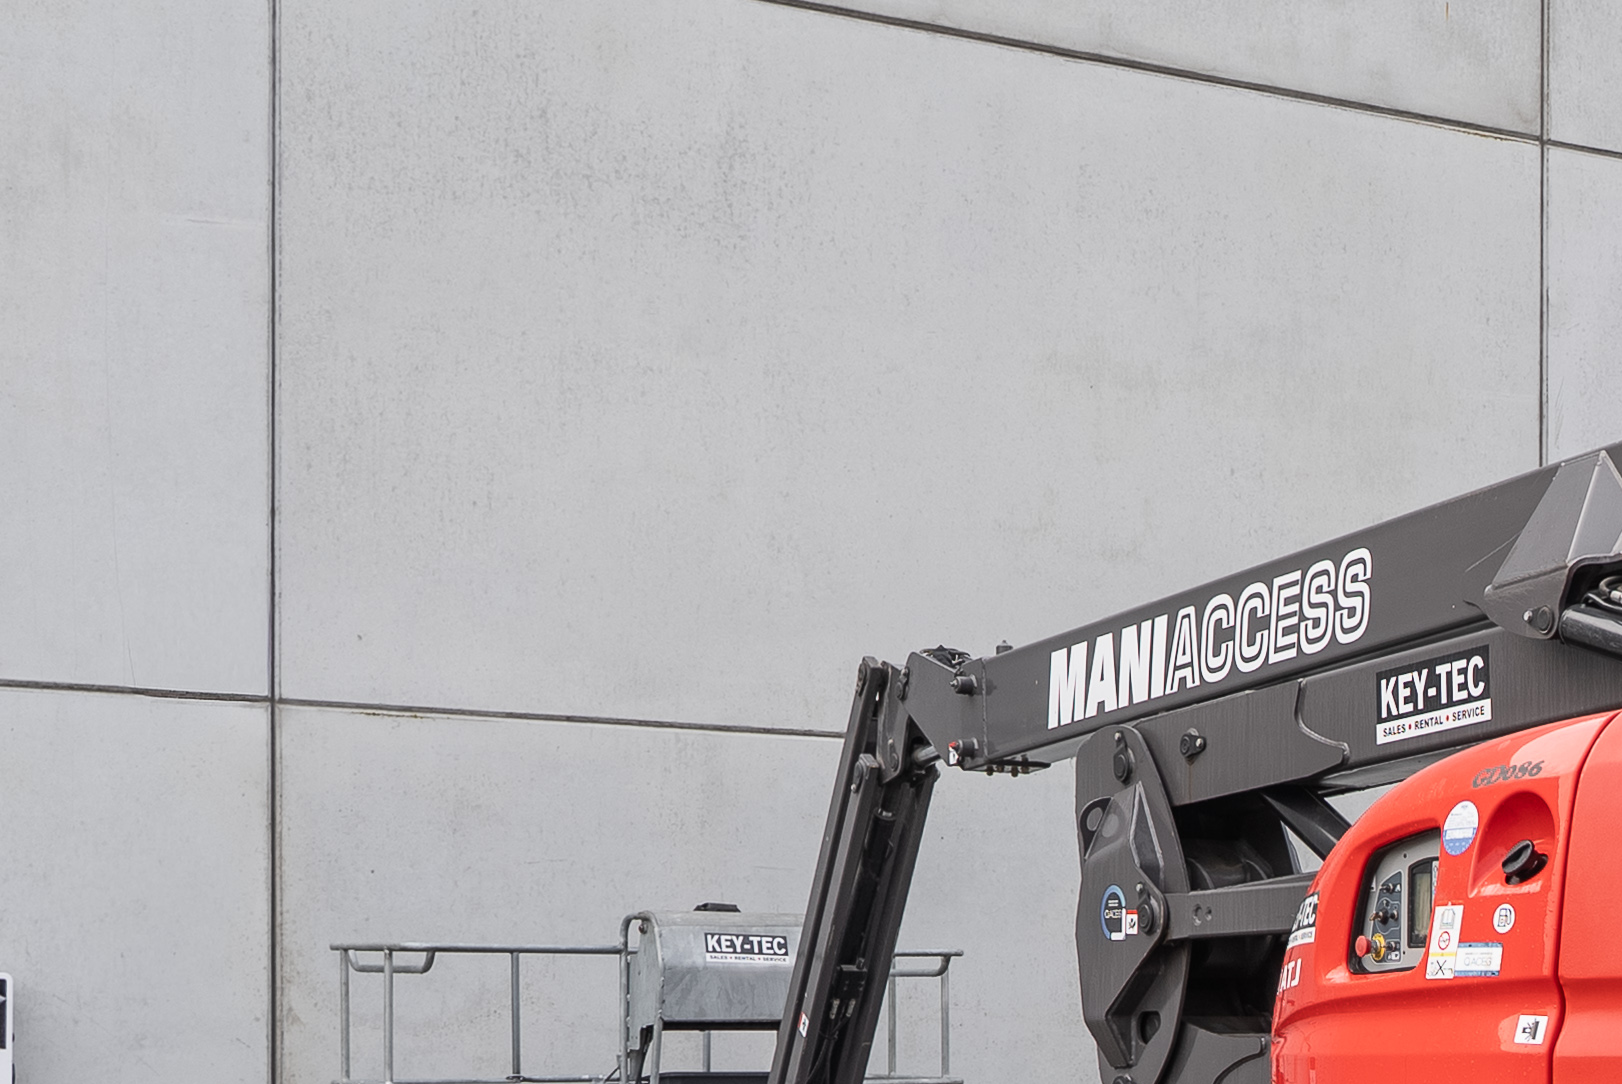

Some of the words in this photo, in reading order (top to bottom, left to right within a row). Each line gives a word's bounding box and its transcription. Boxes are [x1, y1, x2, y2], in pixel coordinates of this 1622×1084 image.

[1047, 547, 1373, 730] MANIACCESS
[1380, 655, 1486, 719] KEY-TEC
[1383, 723, 1406, 737] SALES
[1414, 717, 1443, 730] RENTAL
[1452, 705, 1485, 722] SERVICE
[706, 934, 787, 955] KEY-TEC
